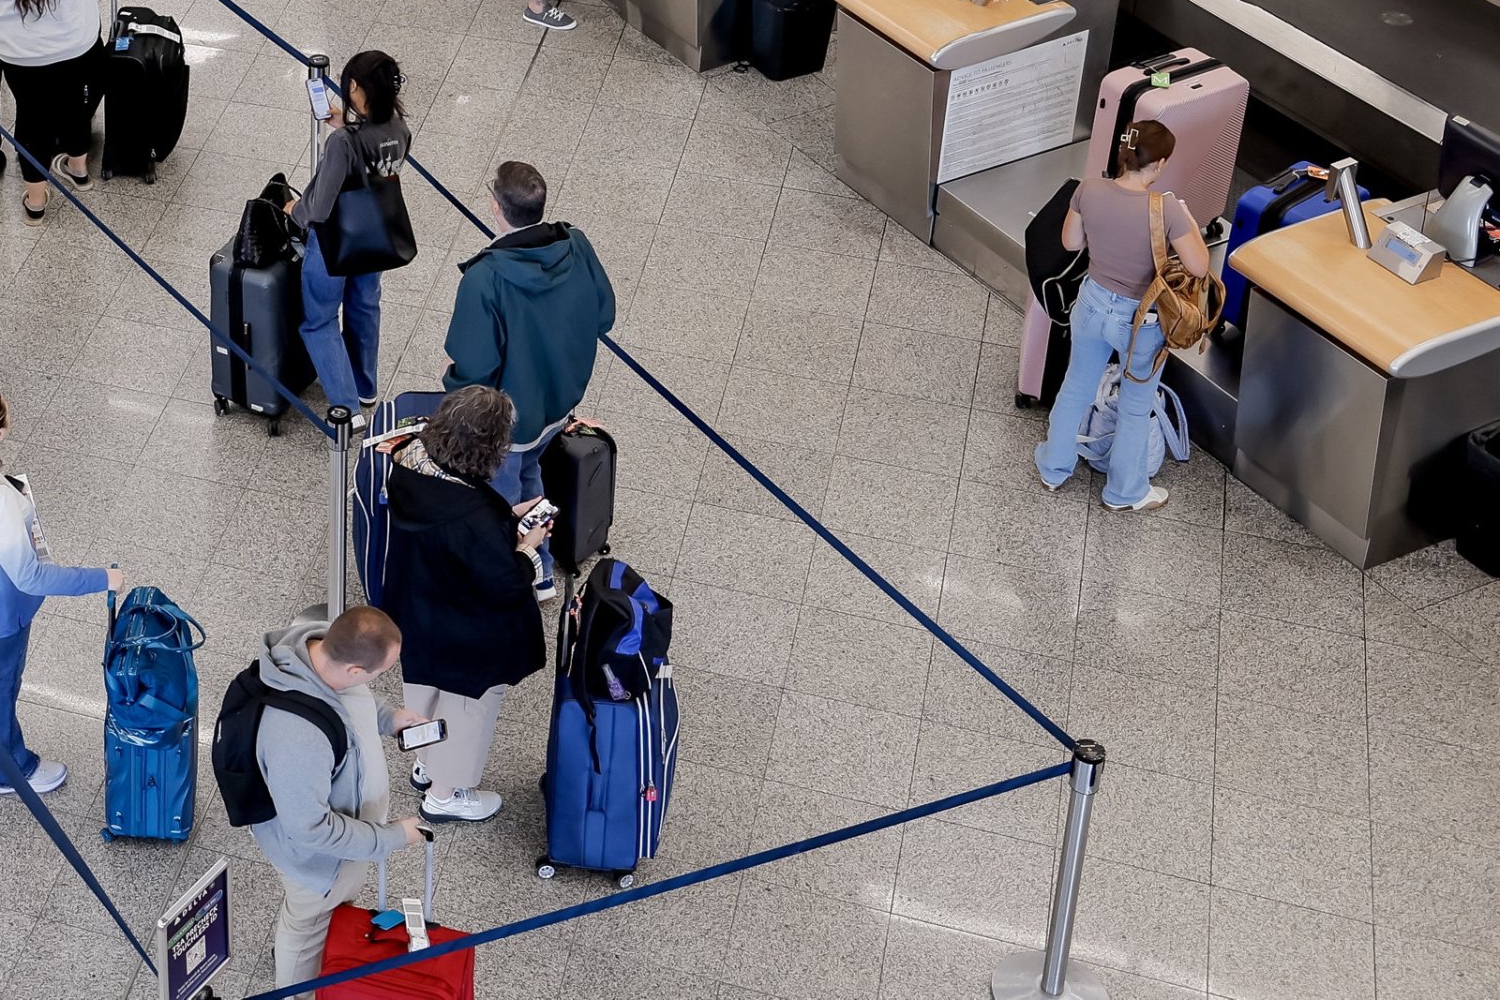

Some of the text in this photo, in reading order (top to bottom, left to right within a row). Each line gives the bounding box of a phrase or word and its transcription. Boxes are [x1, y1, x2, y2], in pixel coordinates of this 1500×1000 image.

[172, 937, 185, 953] TSA
[185, 903, 219, 940] PRECHECK
[182, 889, 208, 918] DELTA
[172, 923, 210, 961] TOUCHLESS
[209, 912, 218, 925] ID
